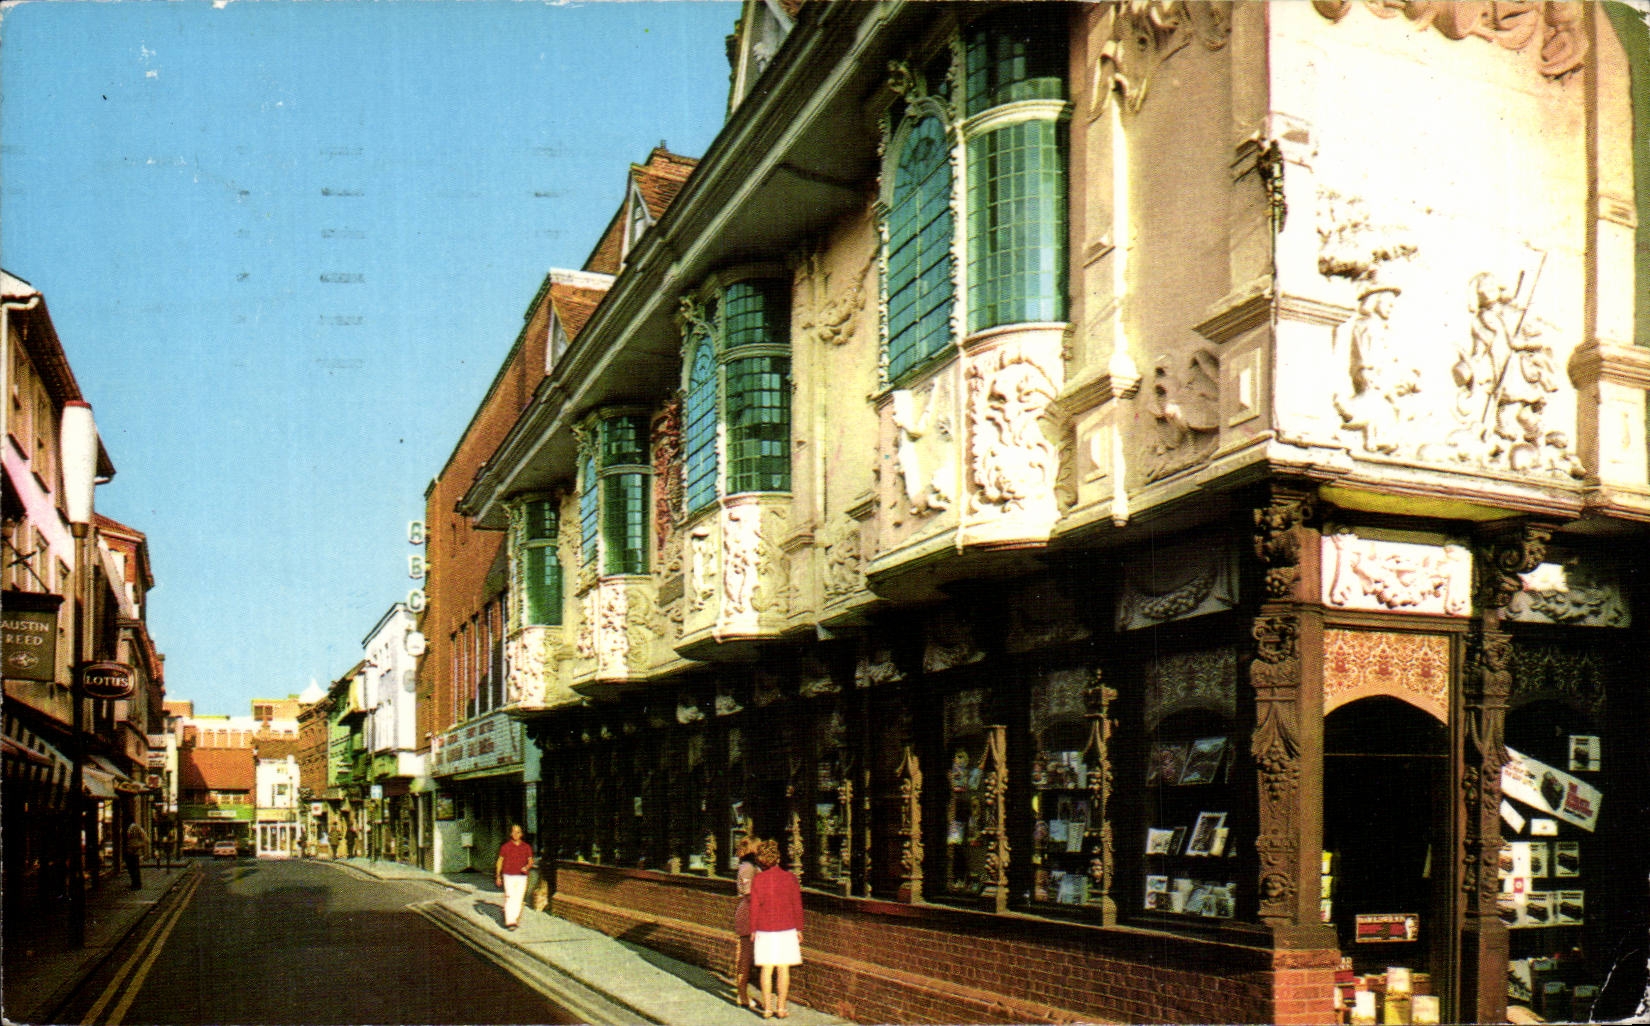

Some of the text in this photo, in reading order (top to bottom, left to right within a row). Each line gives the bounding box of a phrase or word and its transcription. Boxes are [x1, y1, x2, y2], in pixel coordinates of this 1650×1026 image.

[1, 620, 49, 632] AUSTIN
[5, 634, 43, 646] REED
[86, 675, 128, 687] LOTUS
